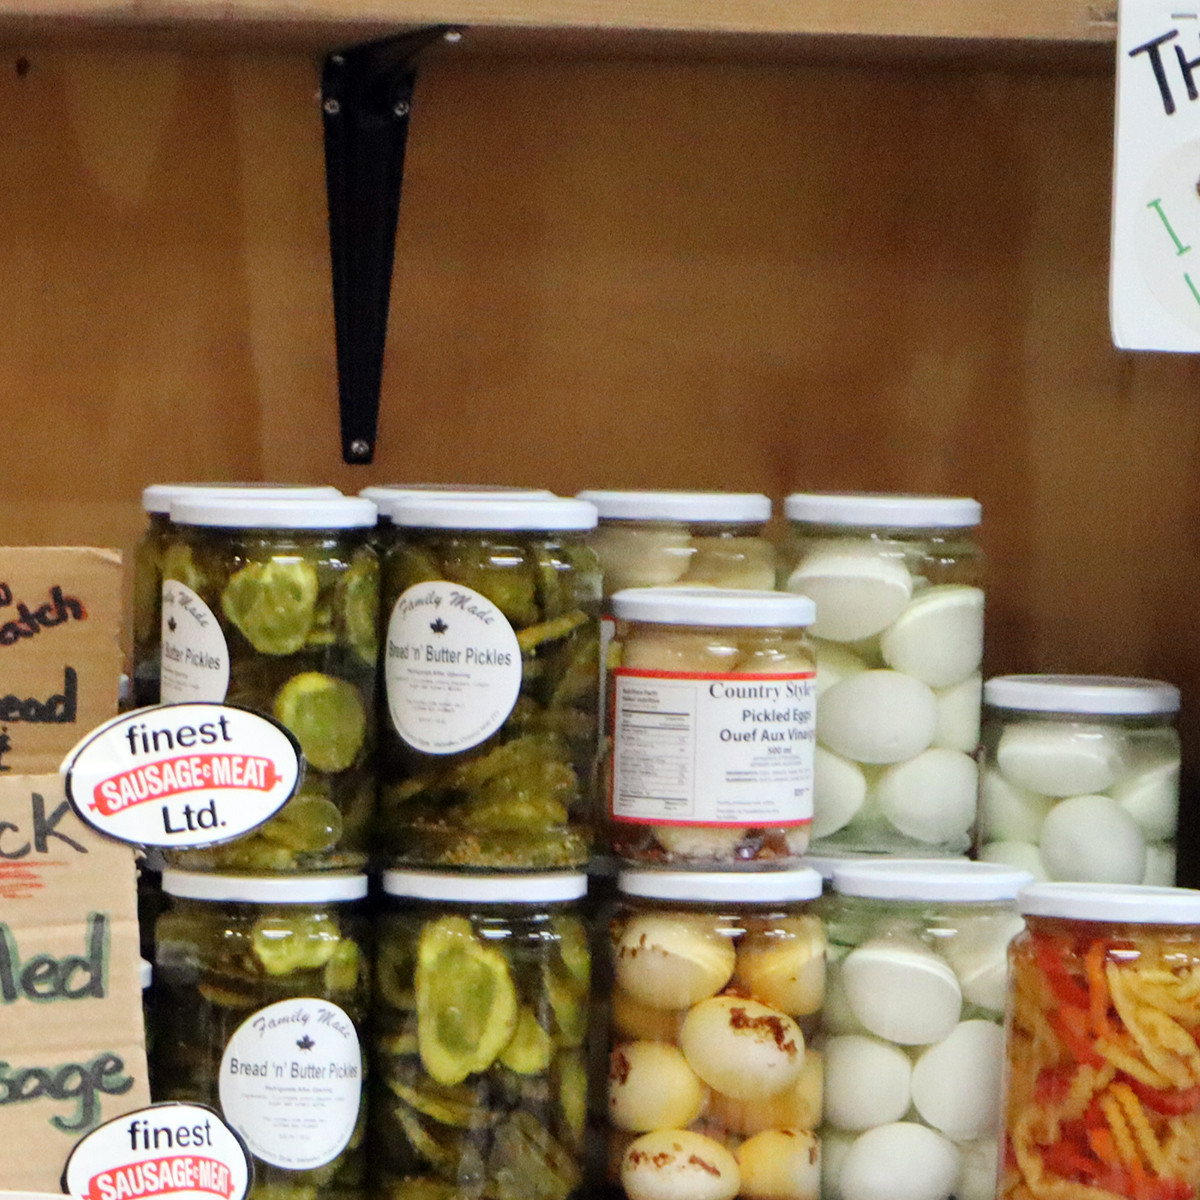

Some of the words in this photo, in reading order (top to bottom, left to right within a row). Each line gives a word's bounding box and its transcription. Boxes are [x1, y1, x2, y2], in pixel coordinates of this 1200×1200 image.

[399, 590, 442, 620] Family
[450, 591, 495, 625] Made
[186, 647, 221, 670] Pickles
[426, 645, 461, 662] Butter
[465, 647, 512, 666] Pickles
[709, 682, 780, 702] Country
[742, 709, 790, 723] Pickled
[125, 715, 232, 756] finest
[720, 729, 757, 742] Ouef
[761, 729, 785, 742] Aux
[162, 800, 227, 834] Ltd.
[252, 1008, 311, 1038] Family
[318, 1008, 351, 1039] Made
[230, 1058, 268, 1077] Bread
[291, 1062, 326, 1079] Butter
[329, 1063, 358, 1079] Pickles
[127, 1118, 213, 1151] finest
